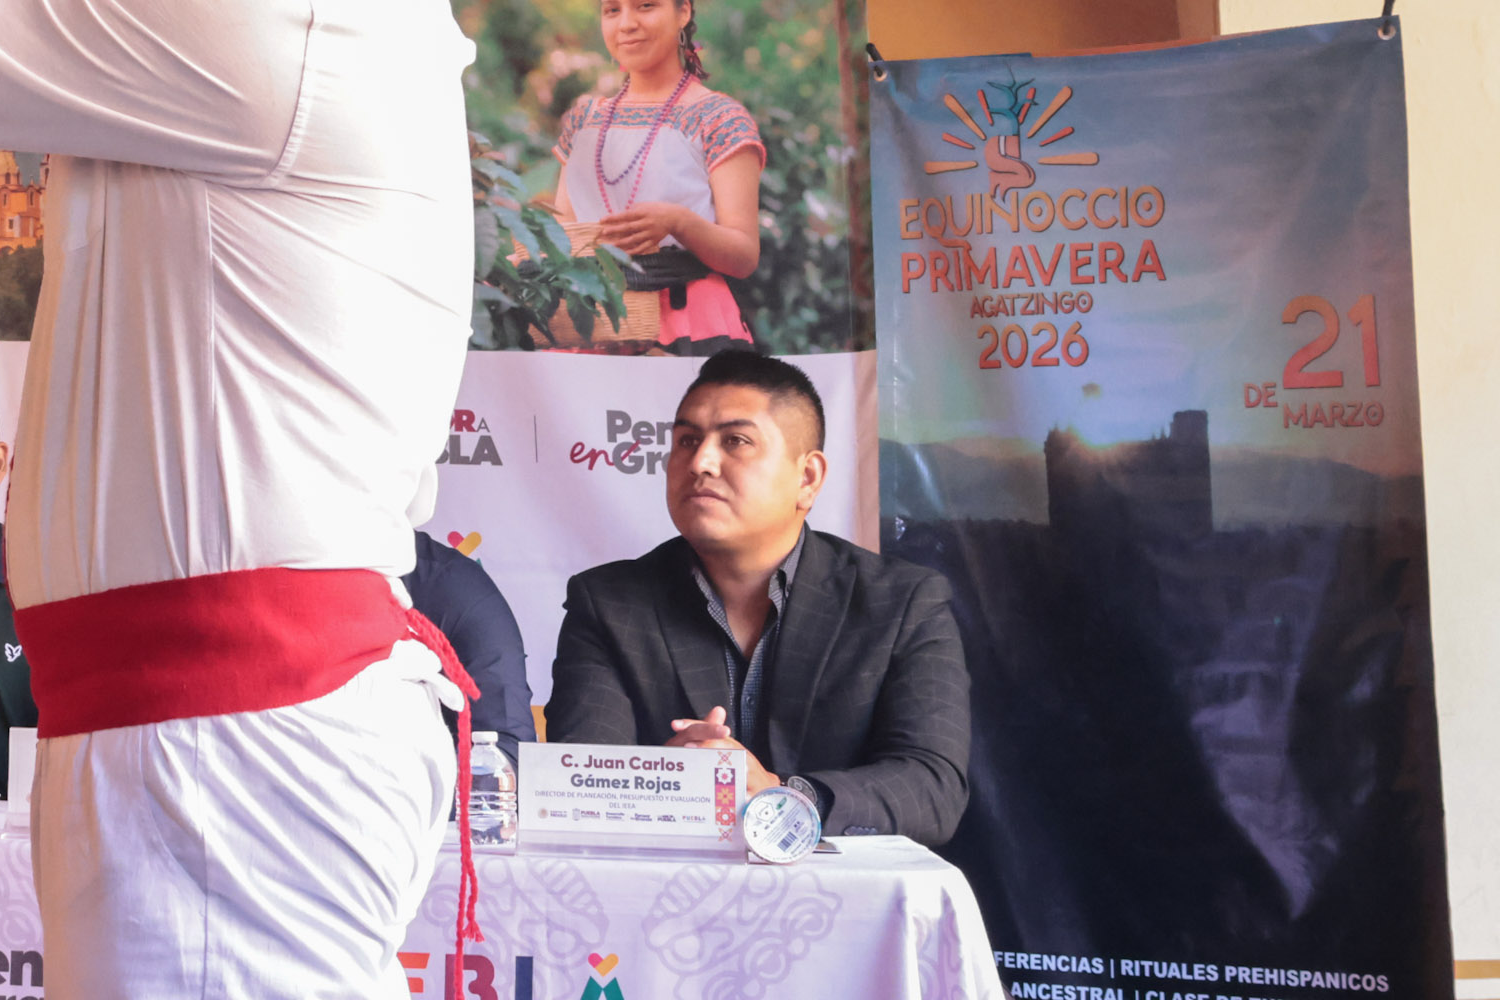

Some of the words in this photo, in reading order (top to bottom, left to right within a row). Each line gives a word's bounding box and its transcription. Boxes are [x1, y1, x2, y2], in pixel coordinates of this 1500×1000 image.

[901, 185, 1165, 245] EQUINOCCIO
[902, 240, 1166, 293] PRIMAVERA
[977, 321, 1089, 369] 2026
[1282, 293, 1381, 389] 21
[1244, 382, 1278, 408] DE
[1283, 402, 1385, 429] MARZO
[561, 754, 578, 768] C.
[583, 755, 624, 769] Juan
[629, 757, 684, 772] Carlos
[571, 773, 629, 789] Gámez
[634, 776, 681, 793] Rojas
[620, 794, 664, 802] PRESUPUESTO
[994, 951, 1104, 975] FERENCIAS
[1120, 959, 1219, 982] RITUALES
[1225, 965, 1389, 992] PREHISPANICOS
[1011, 981, 1123, 1000] ANCESTRAL
